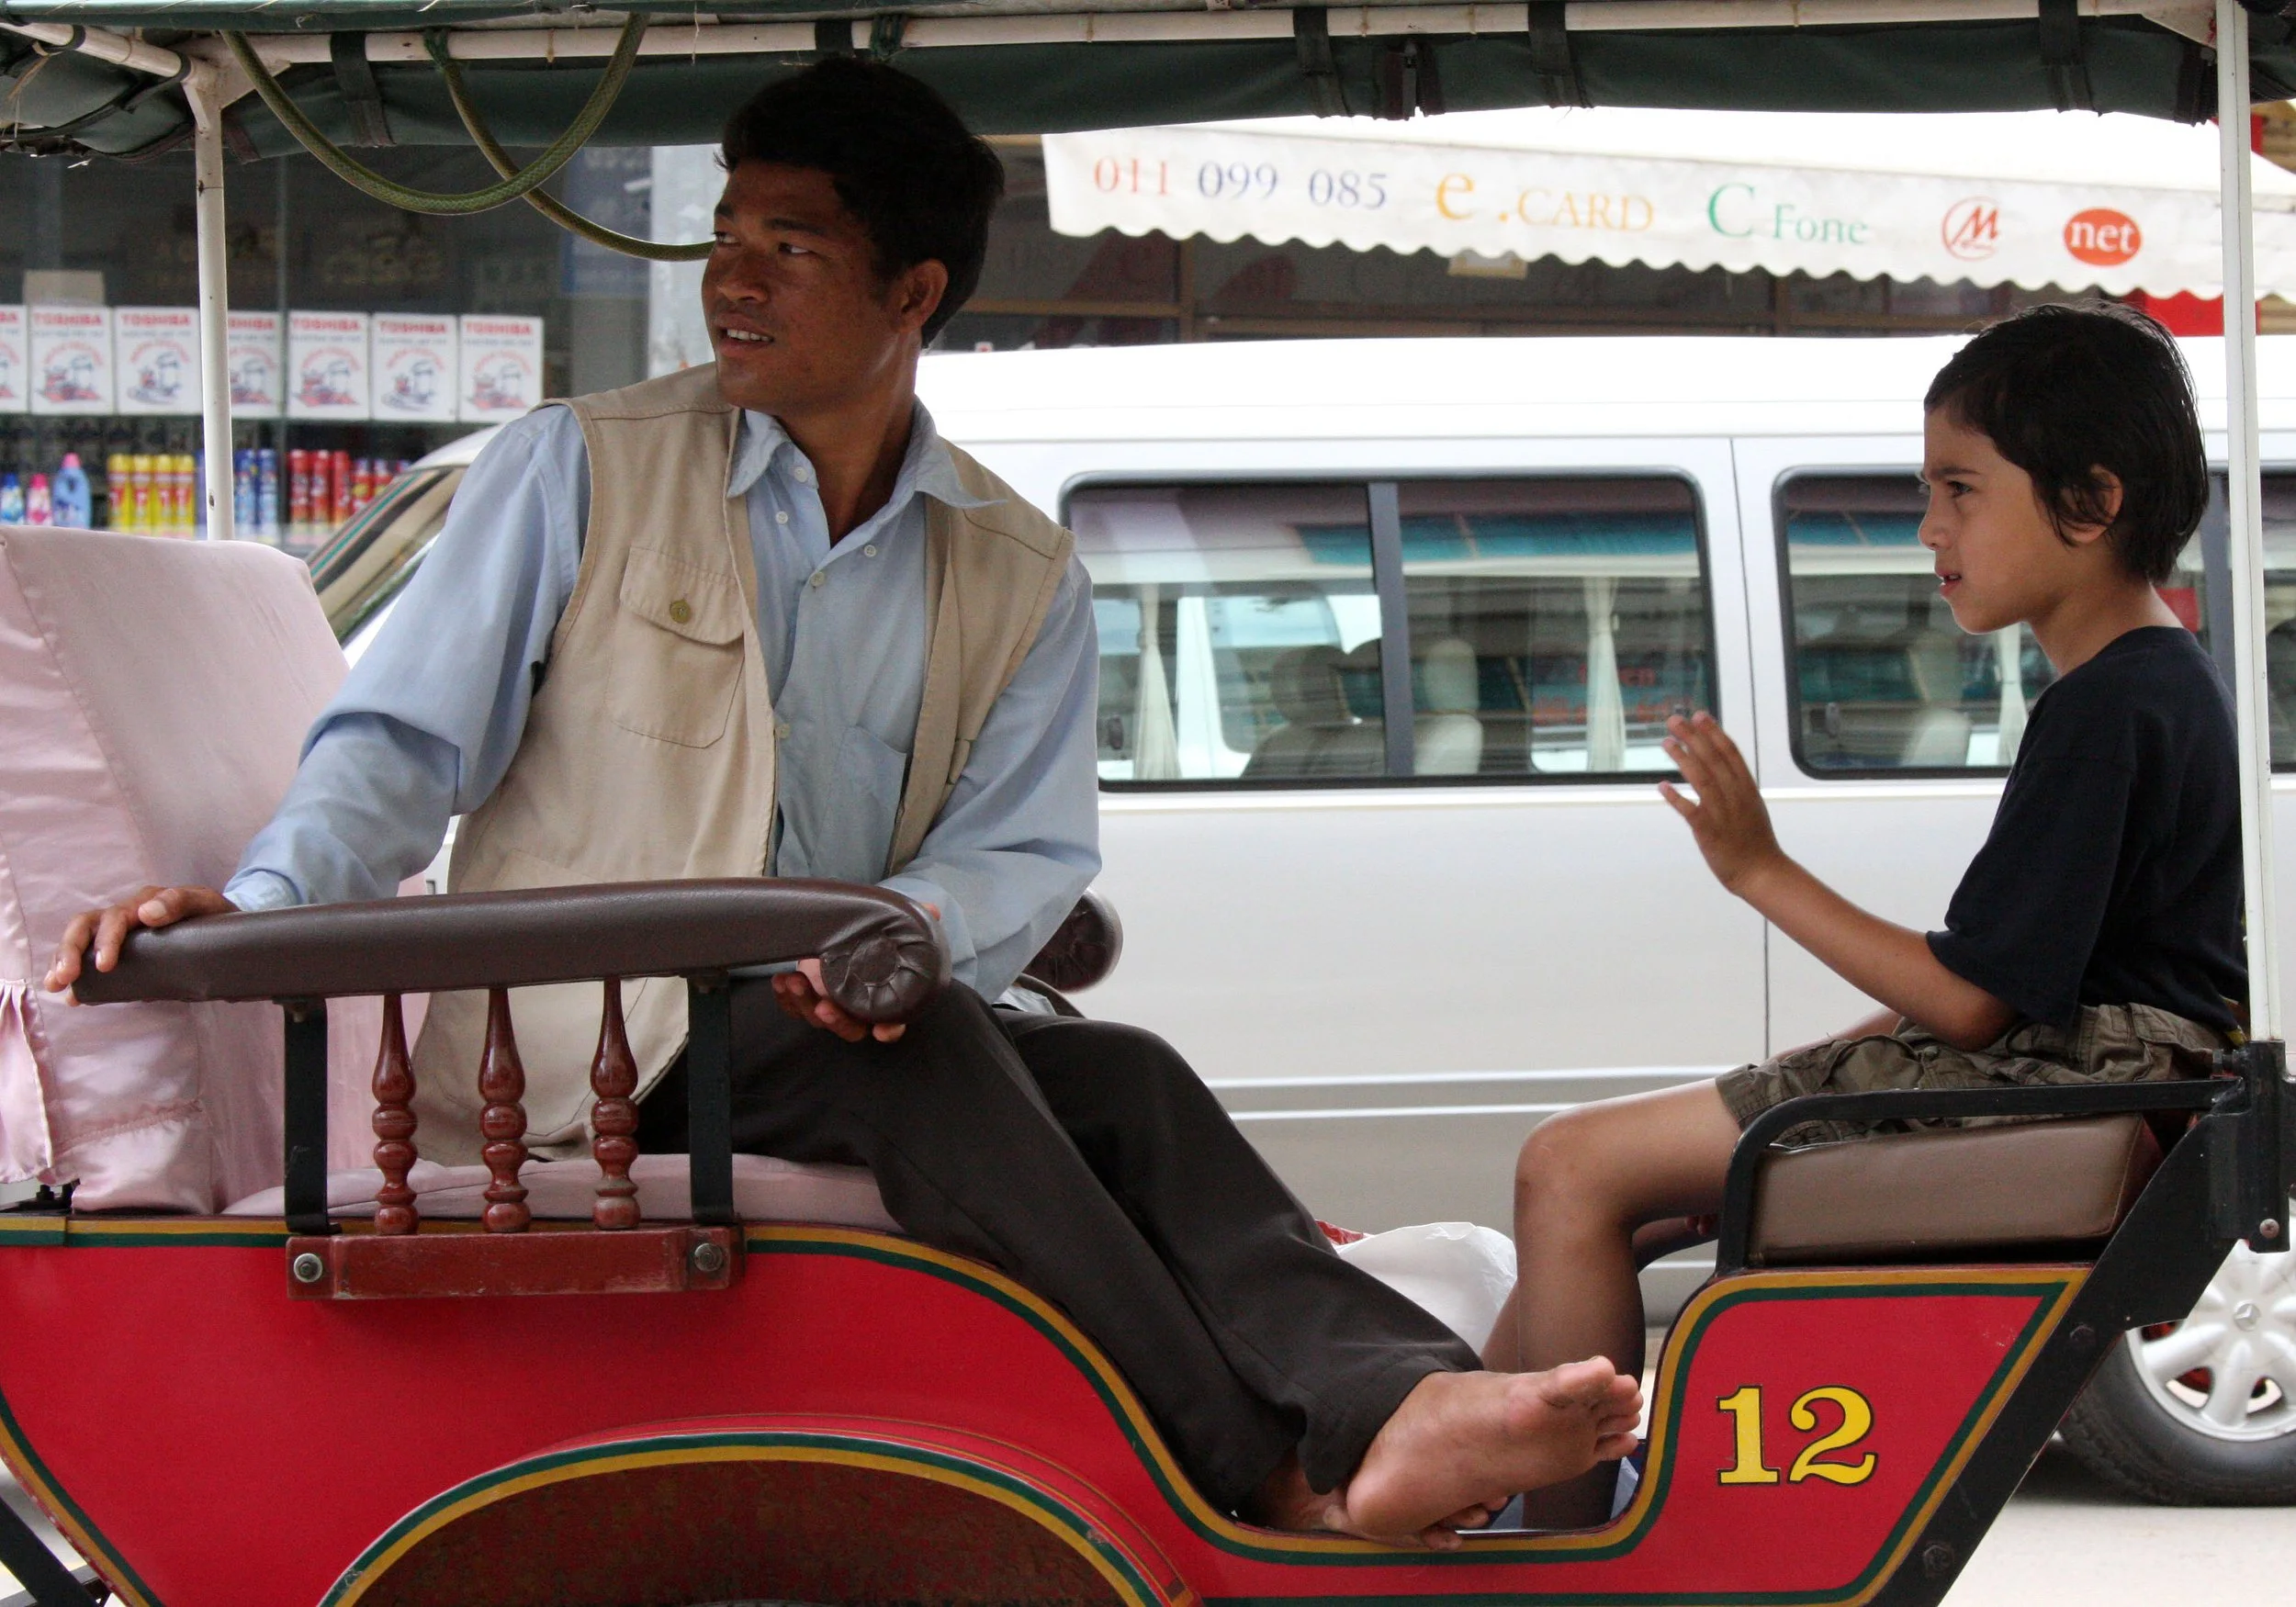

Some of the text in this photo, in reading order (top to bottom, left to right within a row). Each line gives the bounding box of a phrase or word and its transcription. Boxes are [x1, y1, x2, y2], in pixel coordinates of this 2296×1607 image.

[1093, 155, 1169, 196] 011
[1198, 160, 1279, 199] 099
[1308, 168, 1390, 210] 085
[1707, 182, 1755, 239] C
[1773, 203, 1869, 244] Fone
[2070, 220, 2134, 254] net
[34, 312, 103, 325] TOSHIBA
[120, 313, 191, 326] TOSHIBA
[228, 318, 276, 331] SHIBA
[292, 318, 360, 331] TOSHIBA
[378, 321, 447, 334] TOSHIBA
[467, 322, 534, 335] TOSHIBA
[1716, 1385, 1878, 1486] 12
